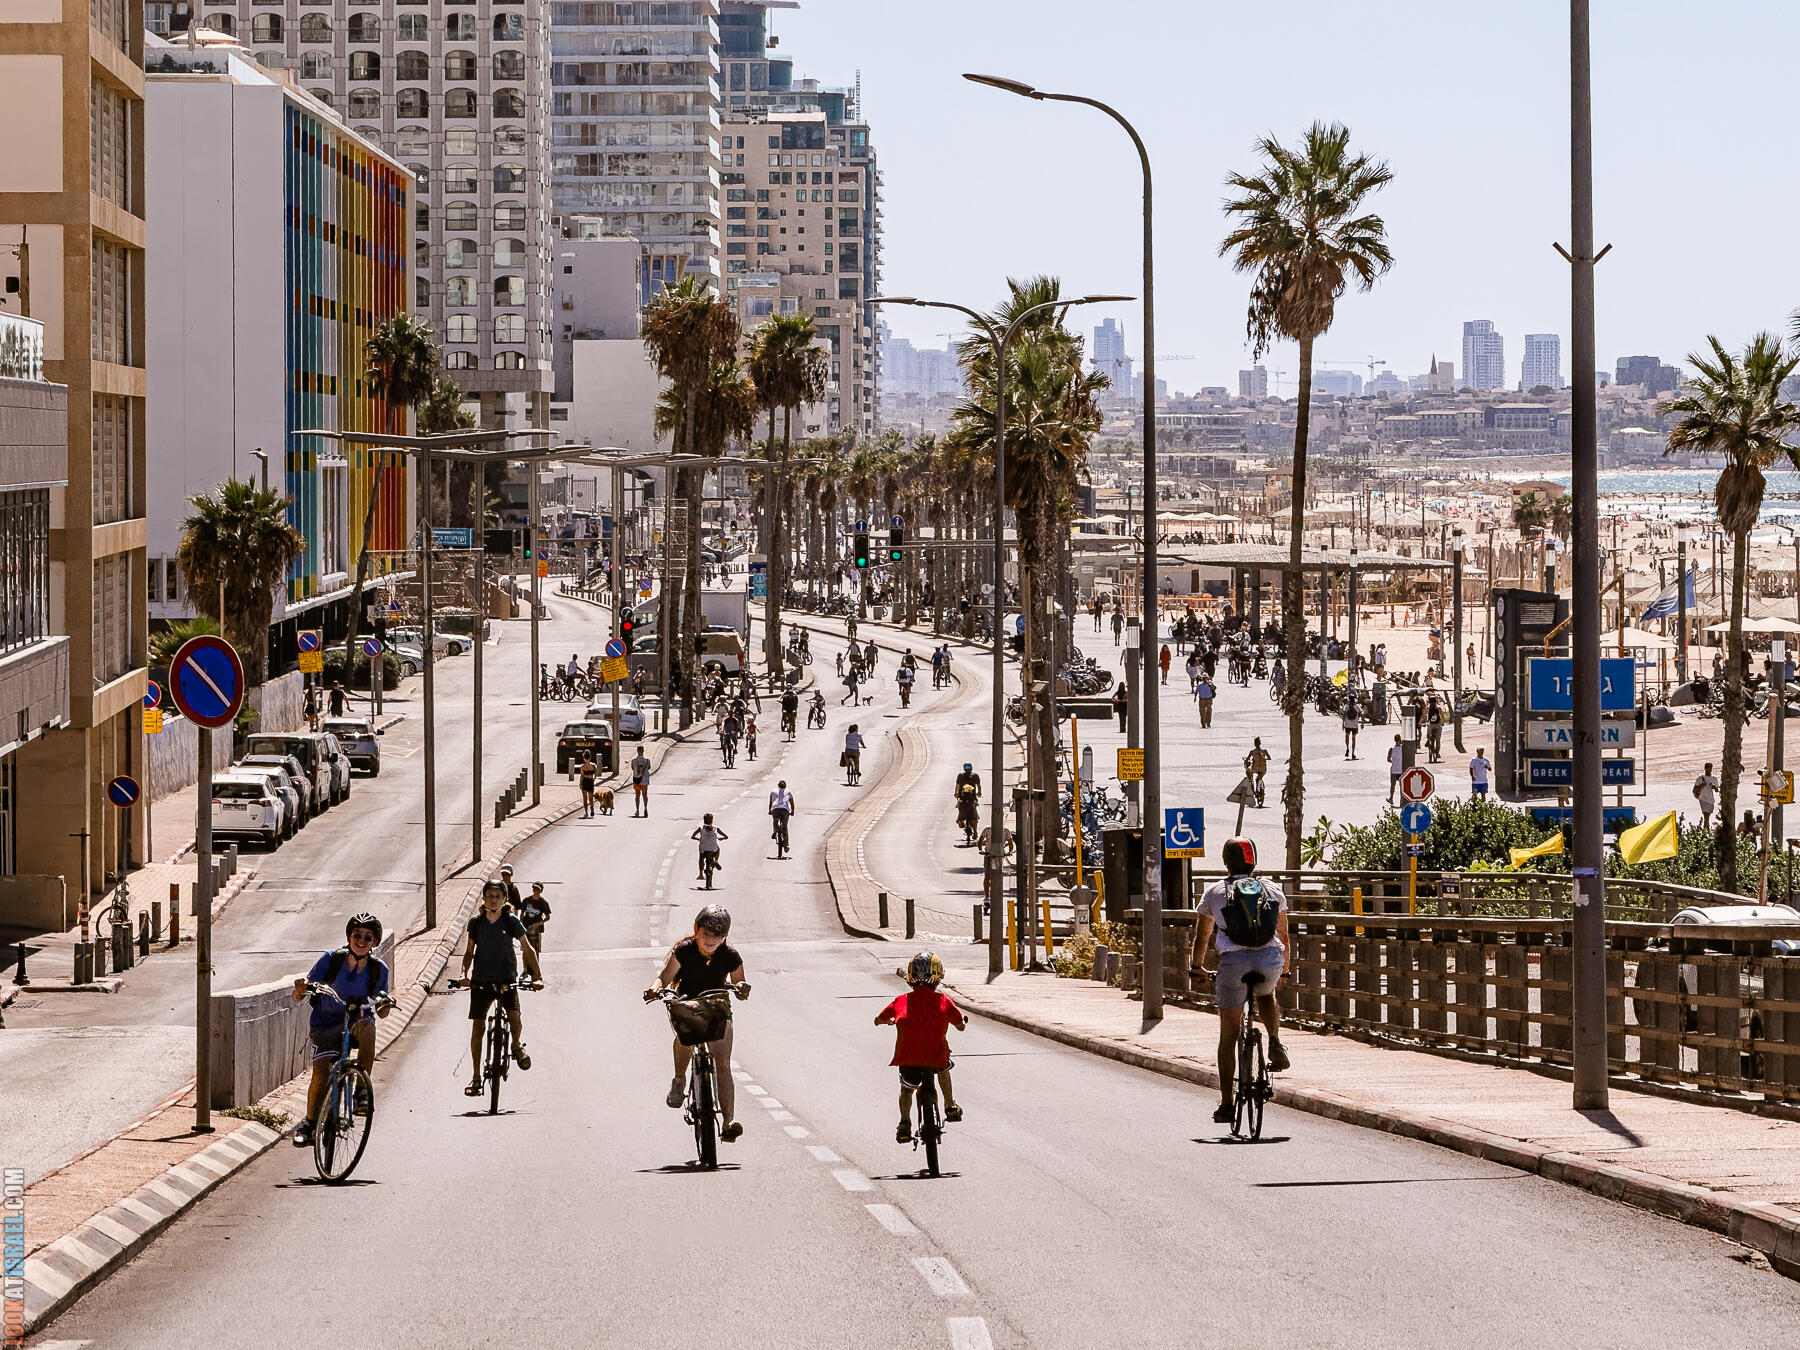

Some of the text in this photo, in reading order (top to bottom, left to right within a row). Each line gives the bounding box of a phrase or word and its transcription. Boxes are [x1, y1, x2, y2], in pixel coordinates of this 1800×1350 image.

[1553, 677, 1613, 695] גו
[1544, 729, 1619, 742] TARN
[1578, 731, 1595, 745] 74
[1533, 768, 1630, 777] GREEK REAM
